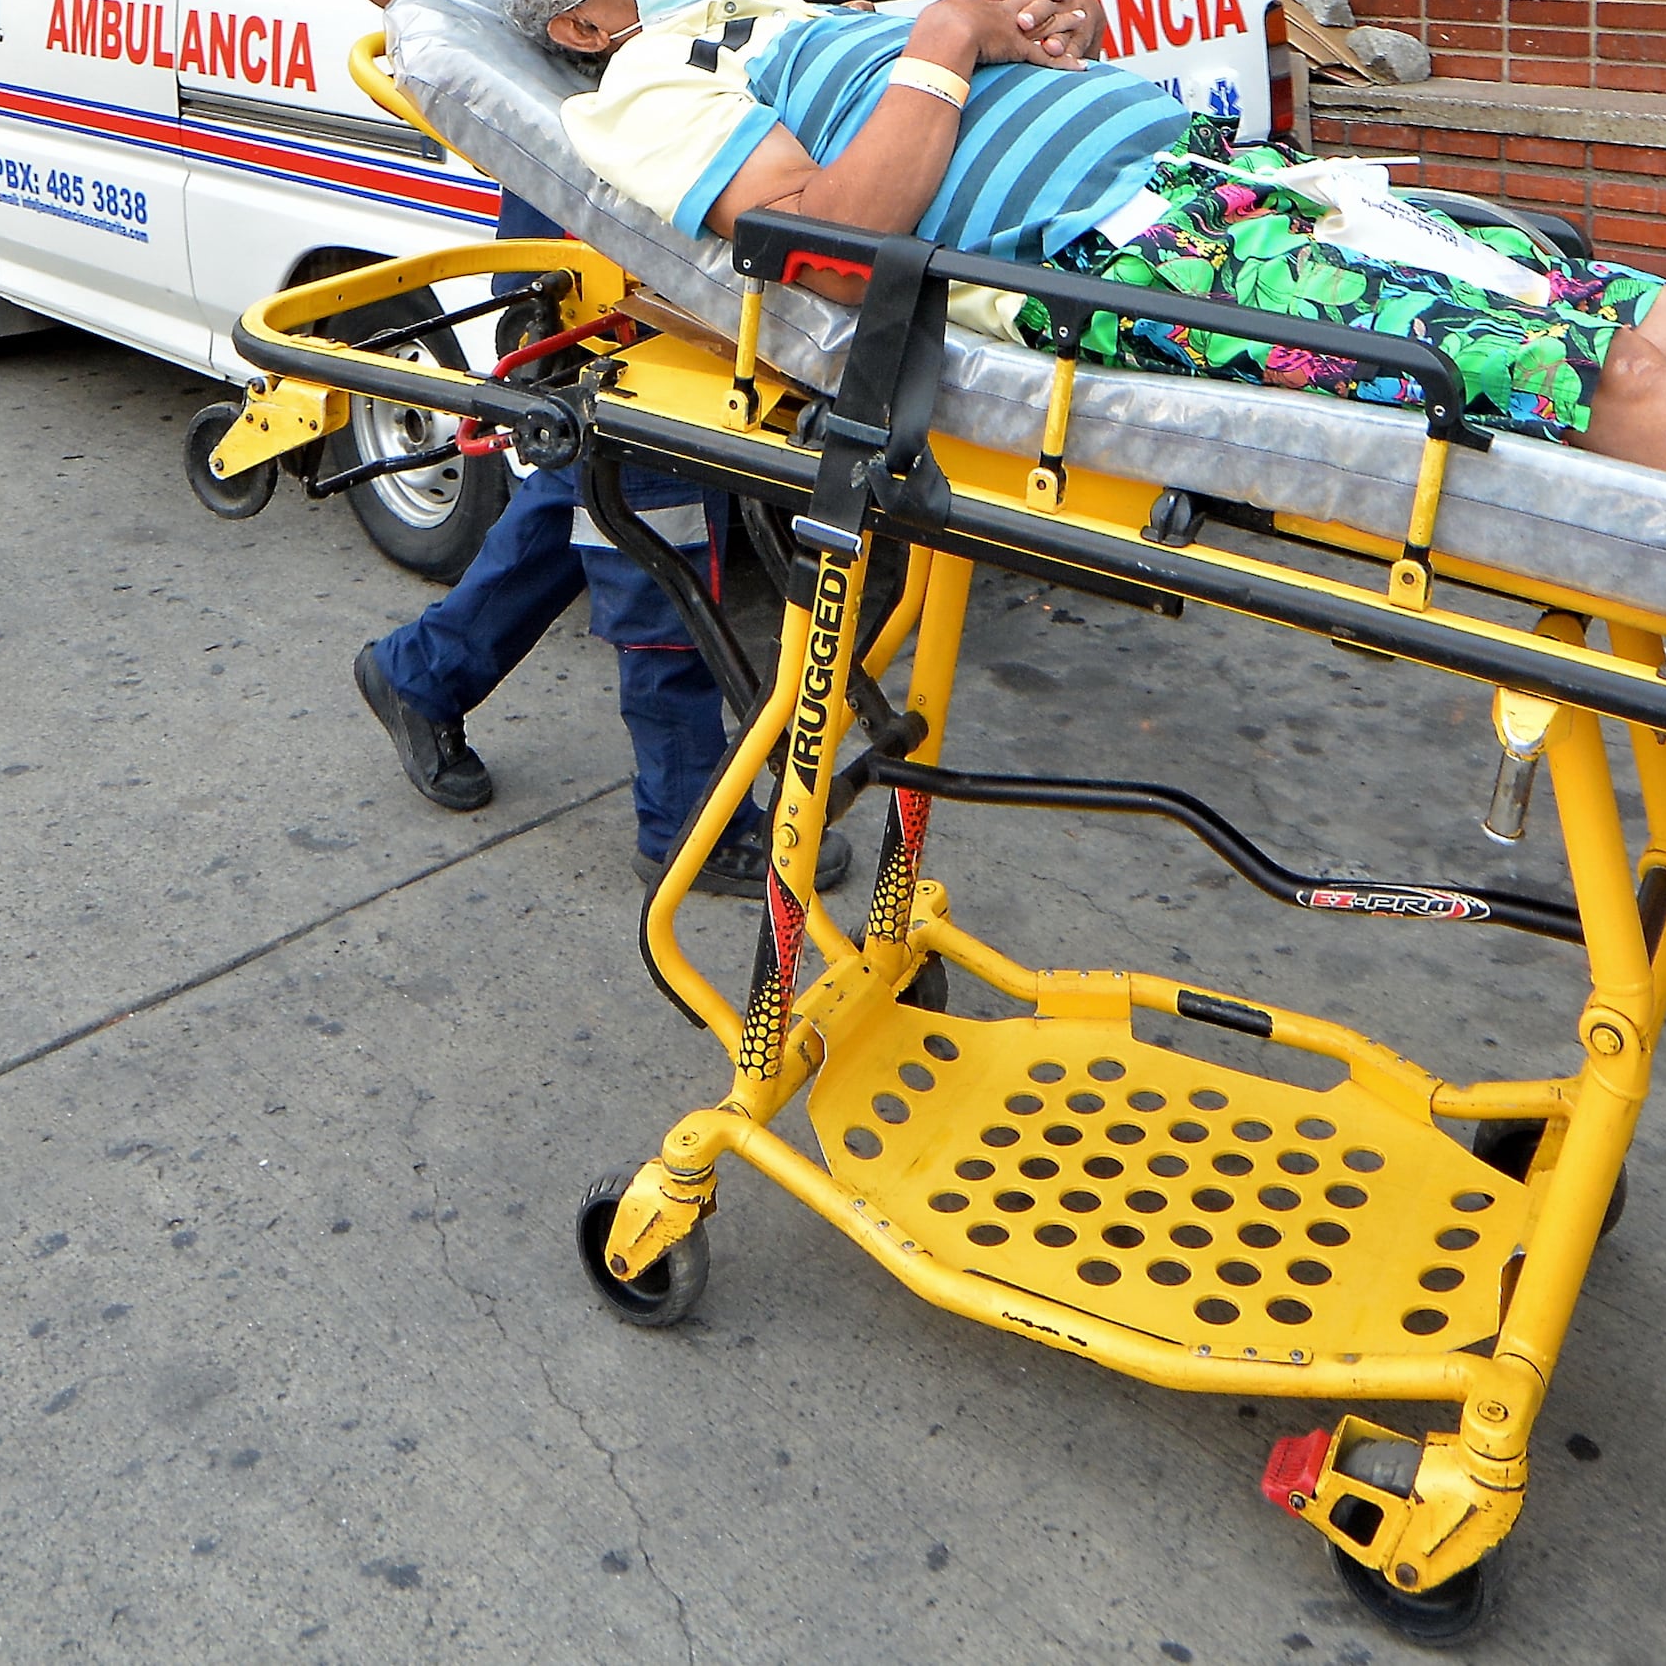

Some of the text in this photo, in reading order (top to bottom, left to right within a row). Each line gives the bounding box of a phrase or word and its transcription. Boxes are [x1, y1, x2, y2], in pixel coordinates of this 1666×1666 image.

[47, 169, 84, 206] 485
[92, 180, 148, 225] 3838
[792, 568, 849, 766] RUGGED
